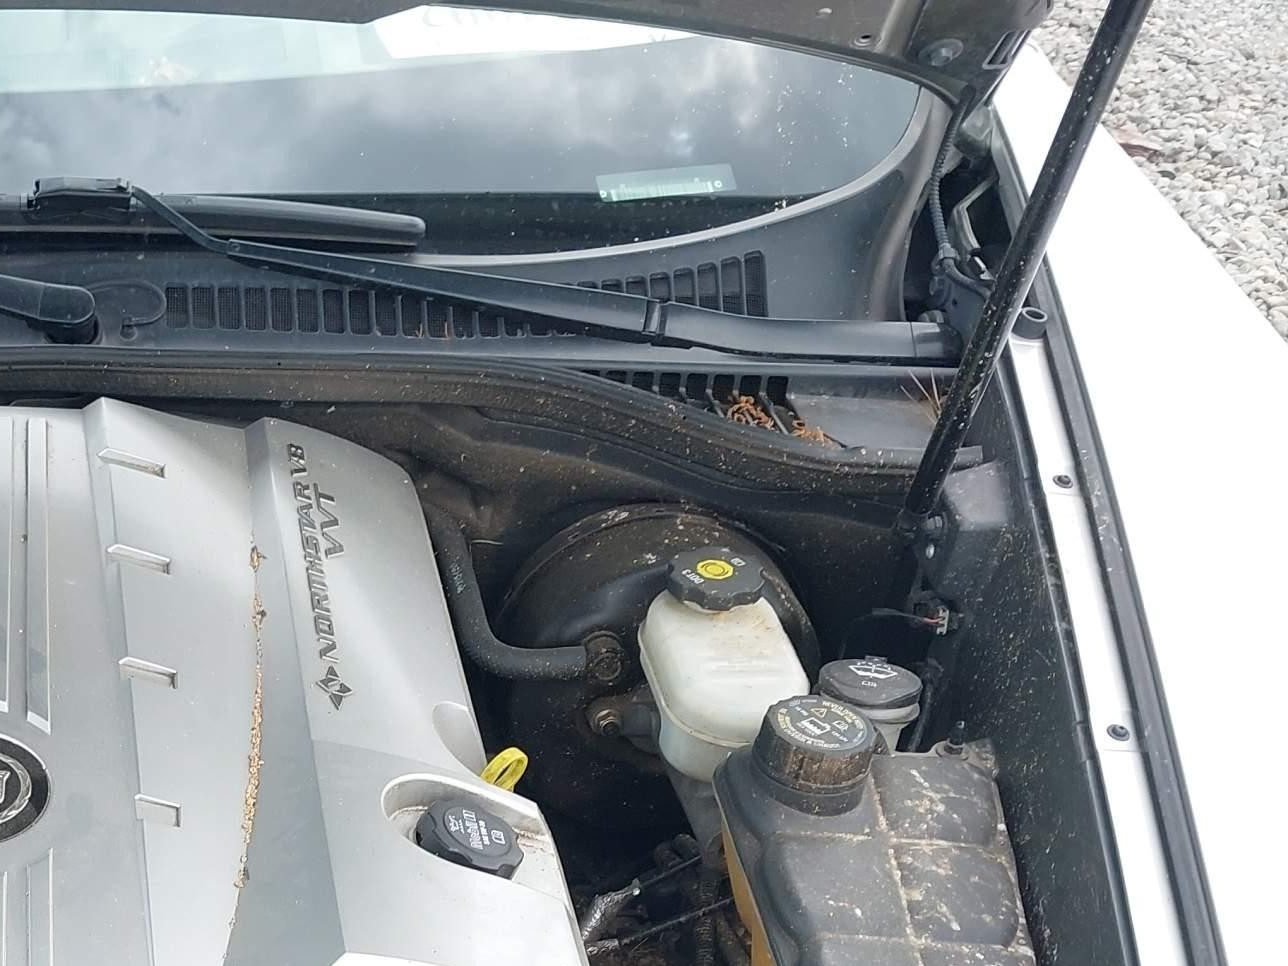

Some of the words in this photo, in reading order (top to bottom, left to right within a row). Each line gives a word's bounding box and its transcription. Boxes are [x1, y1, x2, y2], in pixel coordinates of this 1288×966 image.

[287, 443, 308, 478] V8
[313, 482, 345, 560] VVT
[293, 481, 340, 664] NORTHSTAR
